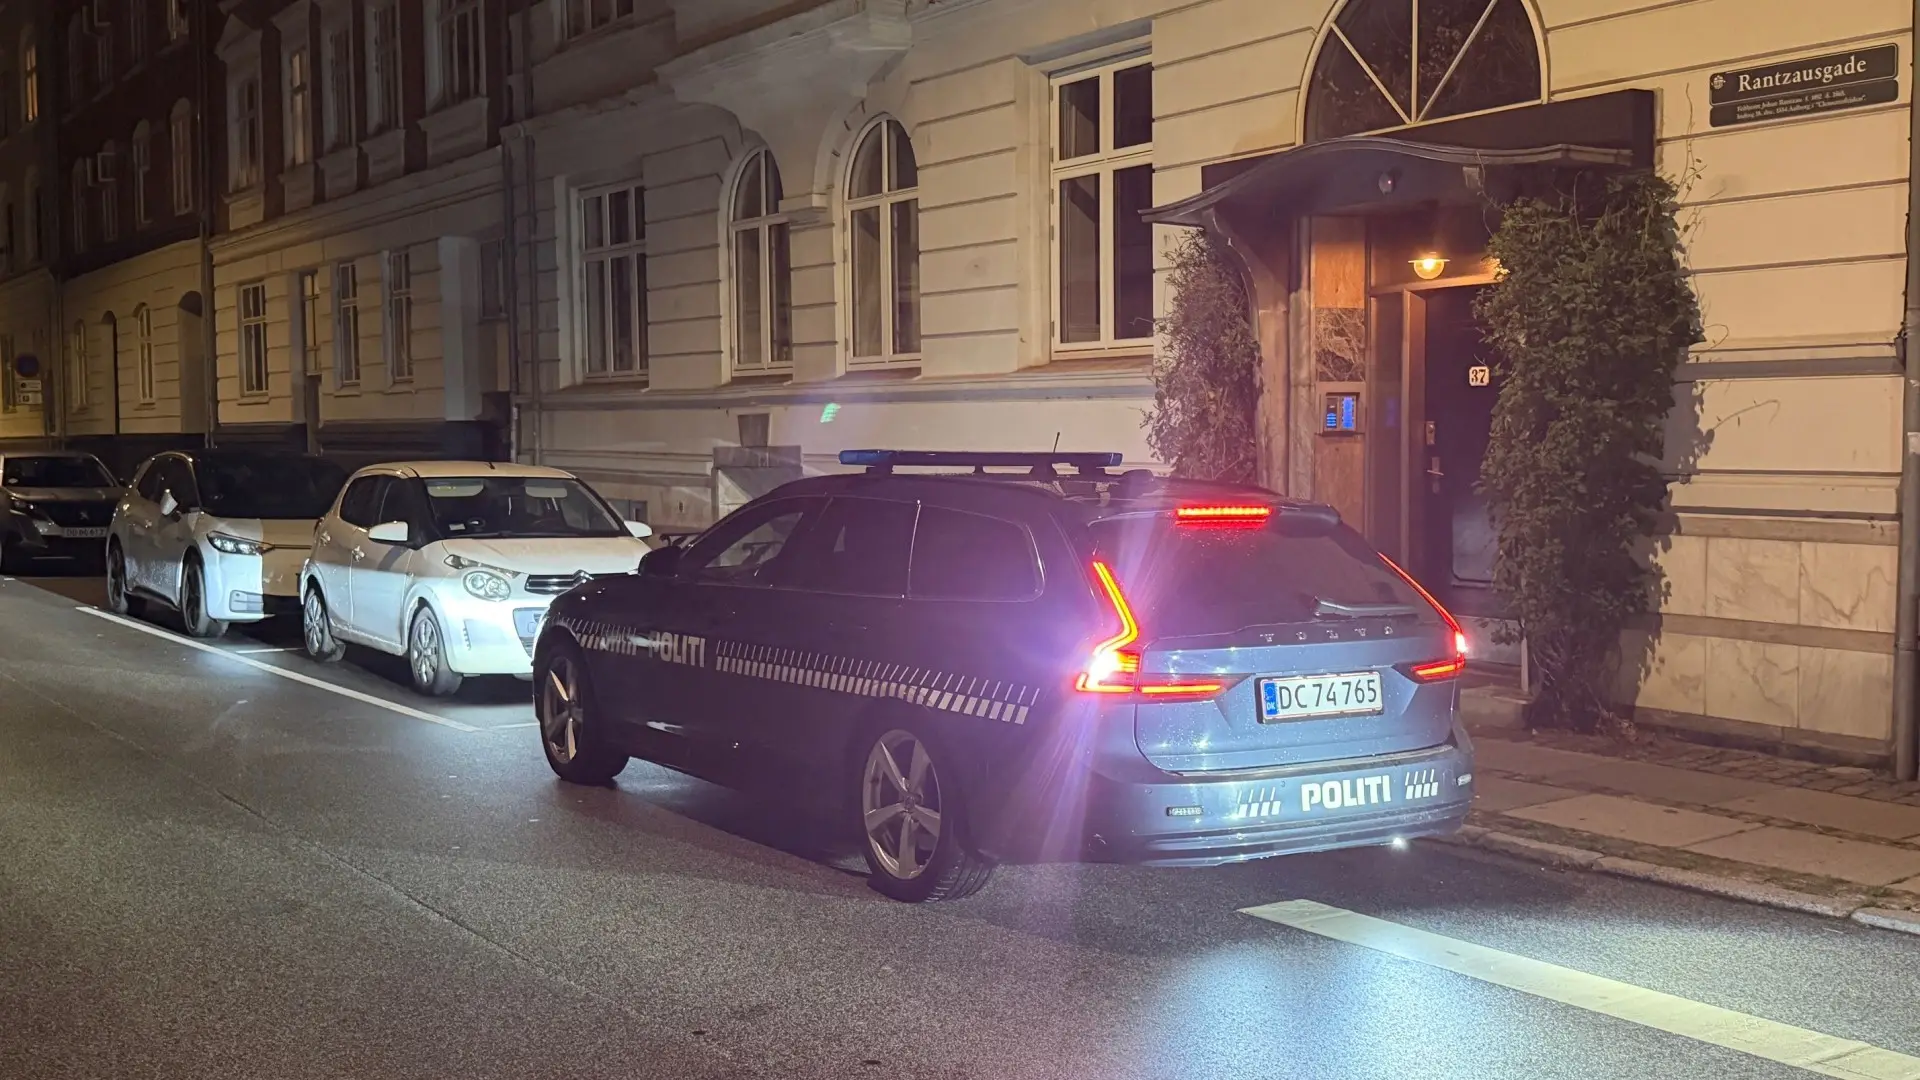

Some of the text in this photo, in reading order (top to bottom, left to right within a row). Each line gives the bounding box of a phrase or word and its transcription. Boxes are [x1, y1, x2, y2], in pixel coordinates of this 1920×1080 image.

[1738, 55, 1867, 92] Rantzausgade
[1471, 369, 1487, 384] 37
[1259, 625, 1394, 643] VOLVO
[649, 631, 706, 668] POLITI
[1266, 701, 1276, 710] DK
[1301, 775, 1392, 812] POLITI
